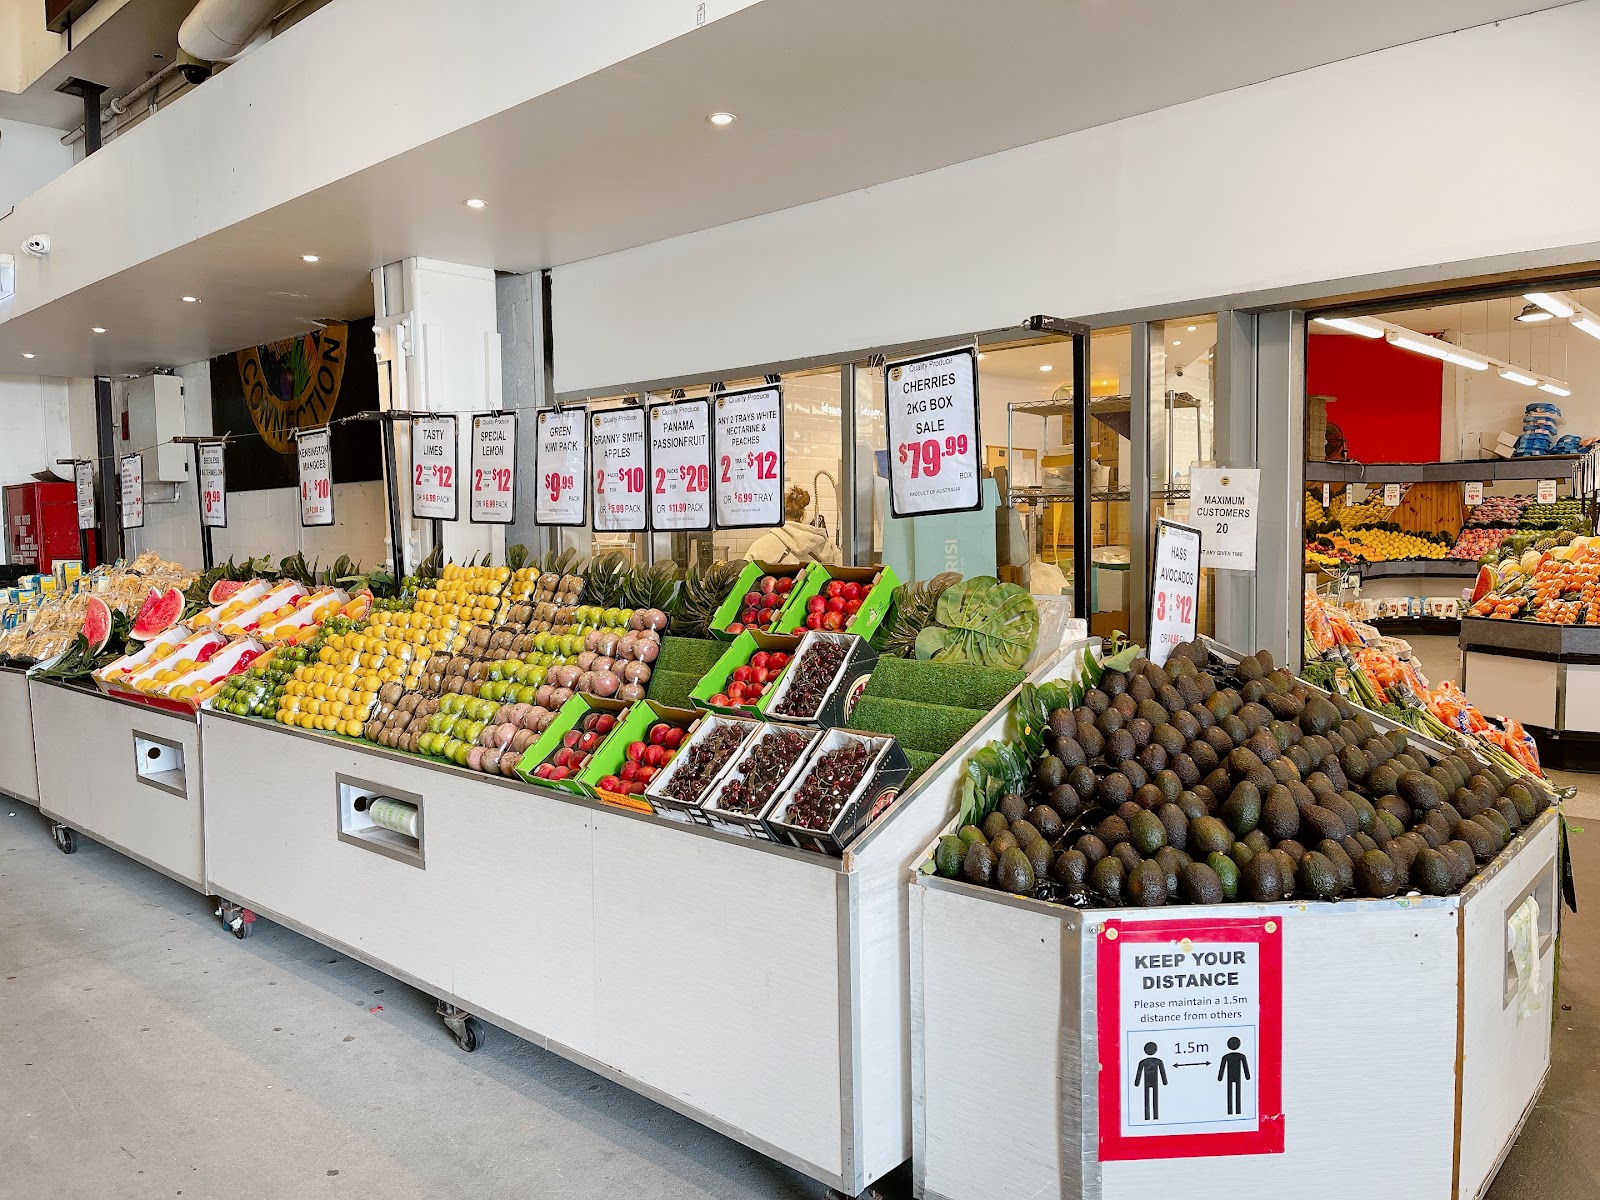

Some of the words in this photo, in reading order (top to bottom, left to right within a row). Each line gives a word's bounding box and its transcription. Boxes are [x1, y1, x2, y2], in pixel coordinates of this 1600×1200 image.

[909, 363, 927, 372] Quality
[929, 358, 953, 367] Produce
[244, 336, 340, 443] CONNECTION
[903, 373, 955, 394] CHERRIES
[907, 400, 926, 415] 2KG
[930, 395, 953, 410] BOX
[718, 417, 730, 425] ANY
[734, 413, 755, 423] TRAYS
[756, 410, 777, 420] WHITE
[550, 426, 572, 437] GREEN
[663, 420, 694, 433] PANAMA
[726, 424, 760, 436] NECTARINE
[762, 424, 766, 432] &
[916, 419, 944, 434] SALE
[423, 430, 444, 440] TASTY
[480, 431, 506, 442] SPECIAL
[594, 434, 620, 446] GRANNY
[622, 432, 643, 443] SMITH
[732, 436, 760, 446] PEACHES
[545, 442, 558, 453] KIWI
[559, 441, 578, 452] PACK
[653, 435, 706, 450] PASSIONFRUIT
[300, 445, 328, 458] KENSINGTON
[424, 446, 443, 456] LIMES
[482, 446, 504, 456] LEMON
[604, 448, 630, 458] APPLES
[899, 434, 967, 479] $79.99
[303, 460, 326, 471] MANGOES
[721, 455, 731, 483] 2
[747, 451, 778, 480] $12
[416, 464, 423, 486] 2
[432, 464, 452, 488] $12
[475, 469, 482, 491] 2
[492, 468, 510, 491] $12
[597, 469, 604, 494] 2
[618, 467, 644, 493] $10
[655, 468, 665, 494] 2
[680, 464, 708, 492] $20
[303, 482, 307, 500] 4
[313, 479, 328, 498] $10
[545, 472, 574, 502] $9.99
[204, 490, 220, 513] $3.99
[436, 495, 450, 503] PACK
[723, 495, 732, 504] OR
[735, 492, 752, 502] $6.99
[754, 493, 773, 502] TRAY
[1204, 496, 1245, 505] MAXIMUM
[600, 505, 606, 514] OR
[608, 503, 624, 513] $5.99
[625, 504, 641, 512] PACK
[657, 504, 666, 513] OR
[669, 503, 686, 512] $11.99
[687, 503, 704, 512] PACK
[1197, 508, 1250, 518] CUSTOMERS
[1169, 528, 1180, 537] Quality
[1216, 523, 1228, 534] 20
[1171, 546, 1188, 561] HASS
[1160, 567, 1194, 585] AVOCADOS
[1157, 592, 1166, 620] 3
[1176, 593, 1192, 624] $12
[1160, 634, 1168, 643] OR
[1135, 954, 1186, 969] KEEP
[1191, 950, 1246, 966] YOUR
[1142, 972, 1239, 990] DISTANCE
[1134, 1000, 1165, 1009] Please
[1168, 997, 1212, 1008] maintain
[1223, 996, 1248, 1005] 1.5m
[1140, 1013, 1181, 1023] distance
[1184, 1012, 1207, 1021] from
[1210, 1010, 1242, 1019] others
[1175, 1042, 1209, 1054] 1.5m
